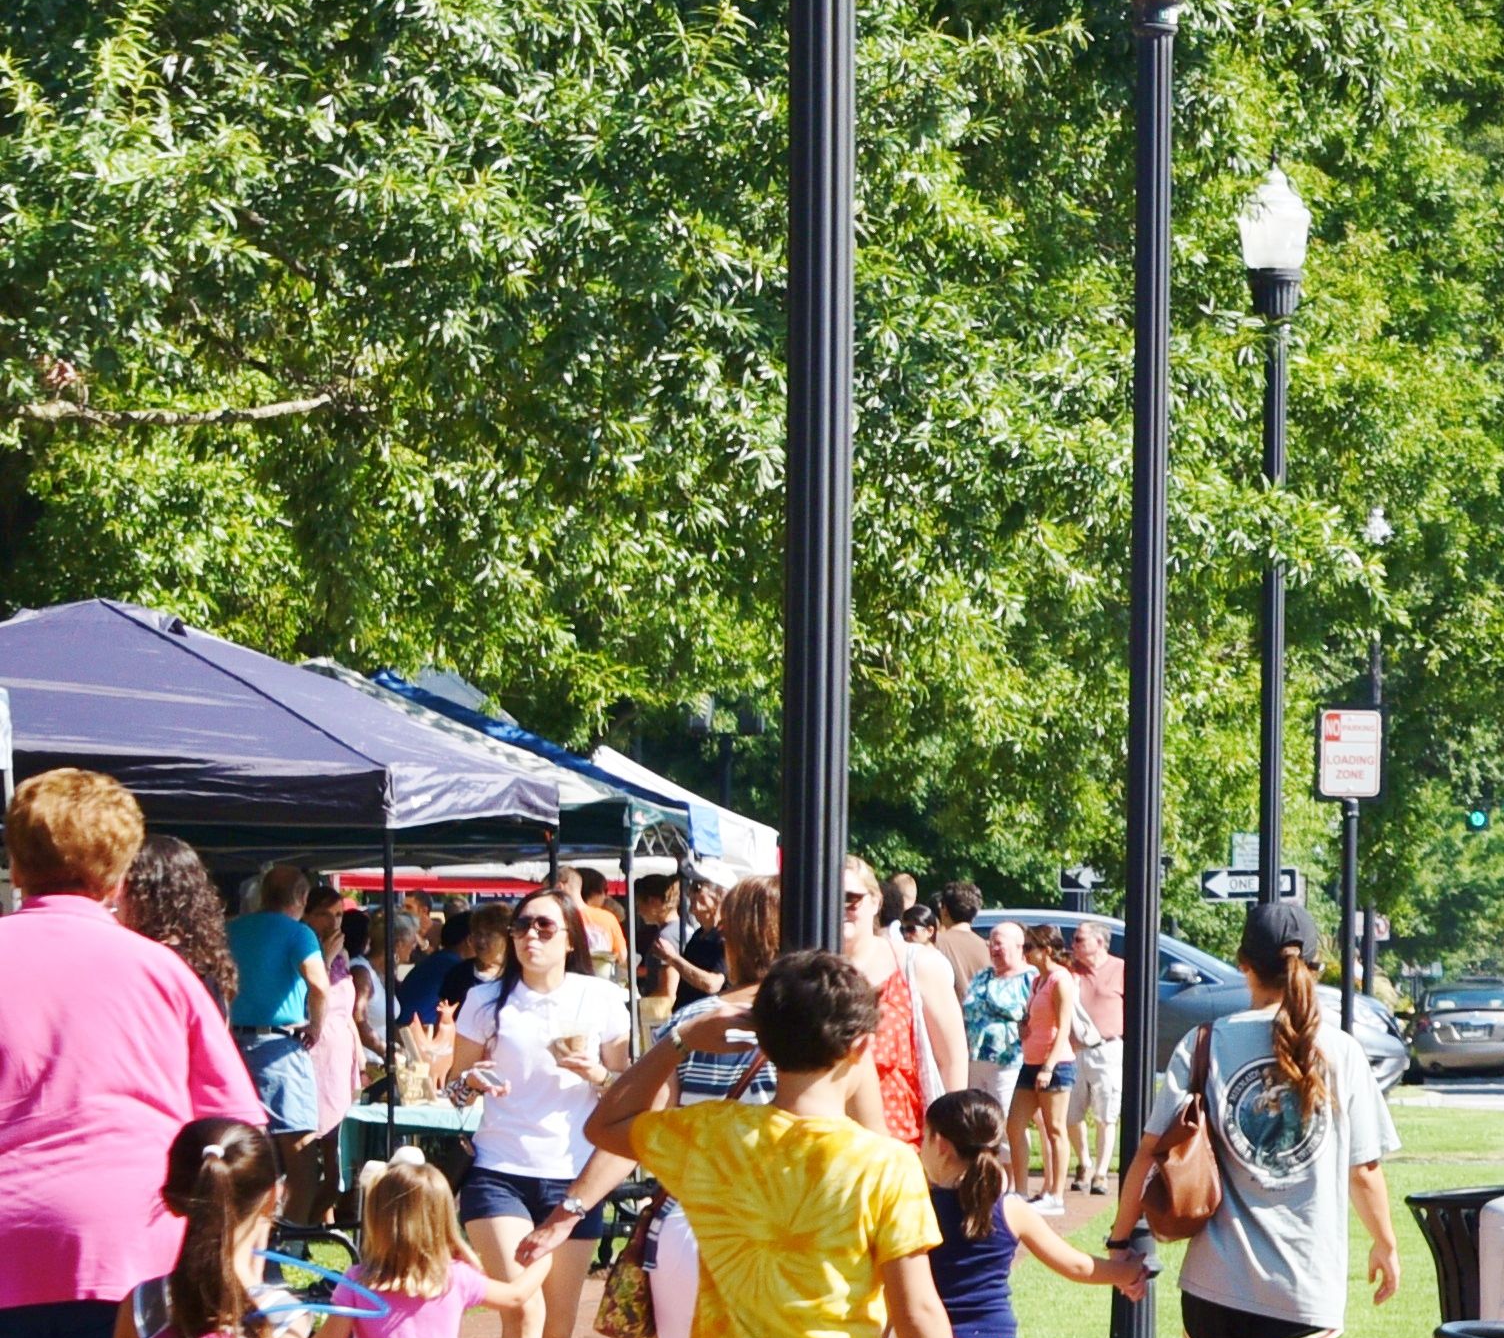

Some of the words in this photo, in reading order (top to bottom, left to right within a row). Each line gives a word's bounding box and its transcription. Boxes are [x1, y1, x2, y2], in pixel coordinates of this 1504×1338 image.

[1326, 719, 1340, 736] NO
[1342, 724, 1376, 732] PARKING
[1326, 755, 1374, 766] LOADING
[1336, 770, 1365, 780] ZONE
[1230, 878, 1255, 889] ONE
